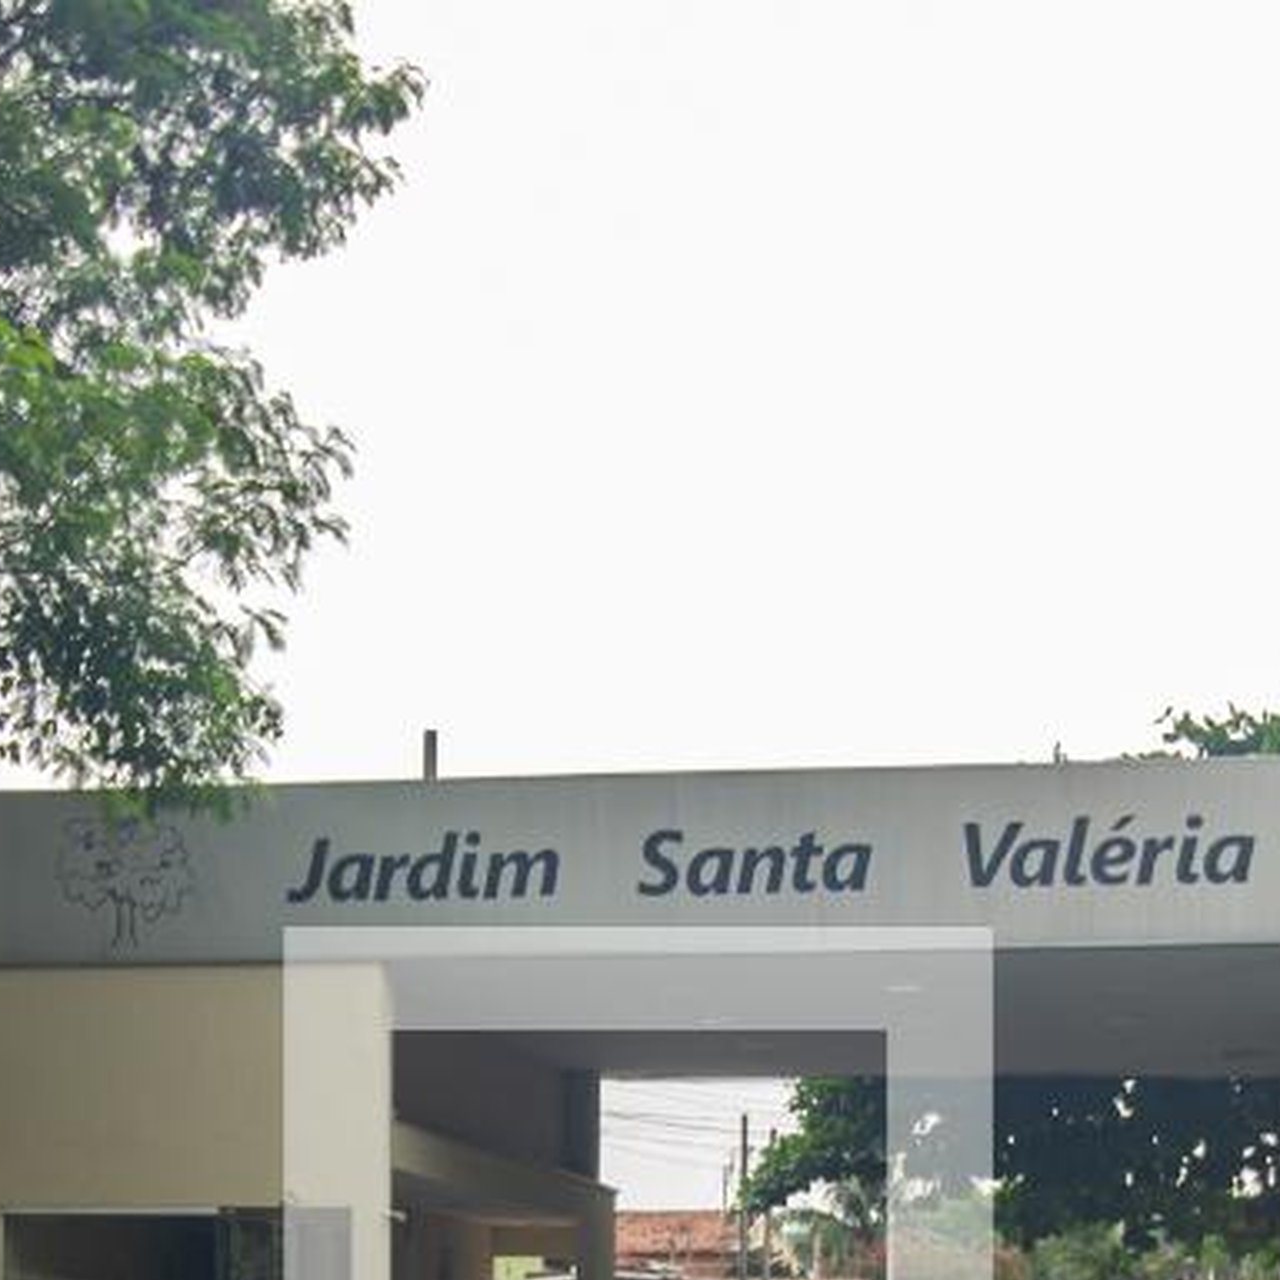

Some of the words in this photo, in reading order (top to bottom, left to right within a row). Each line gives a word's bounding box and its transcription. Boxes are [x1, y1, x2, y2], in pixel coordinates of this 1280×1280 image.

[286, 831, 561, 903] Jardim
[637, 829, 872, 898] Santa
[962, 815, 1256, 888] Valéria
